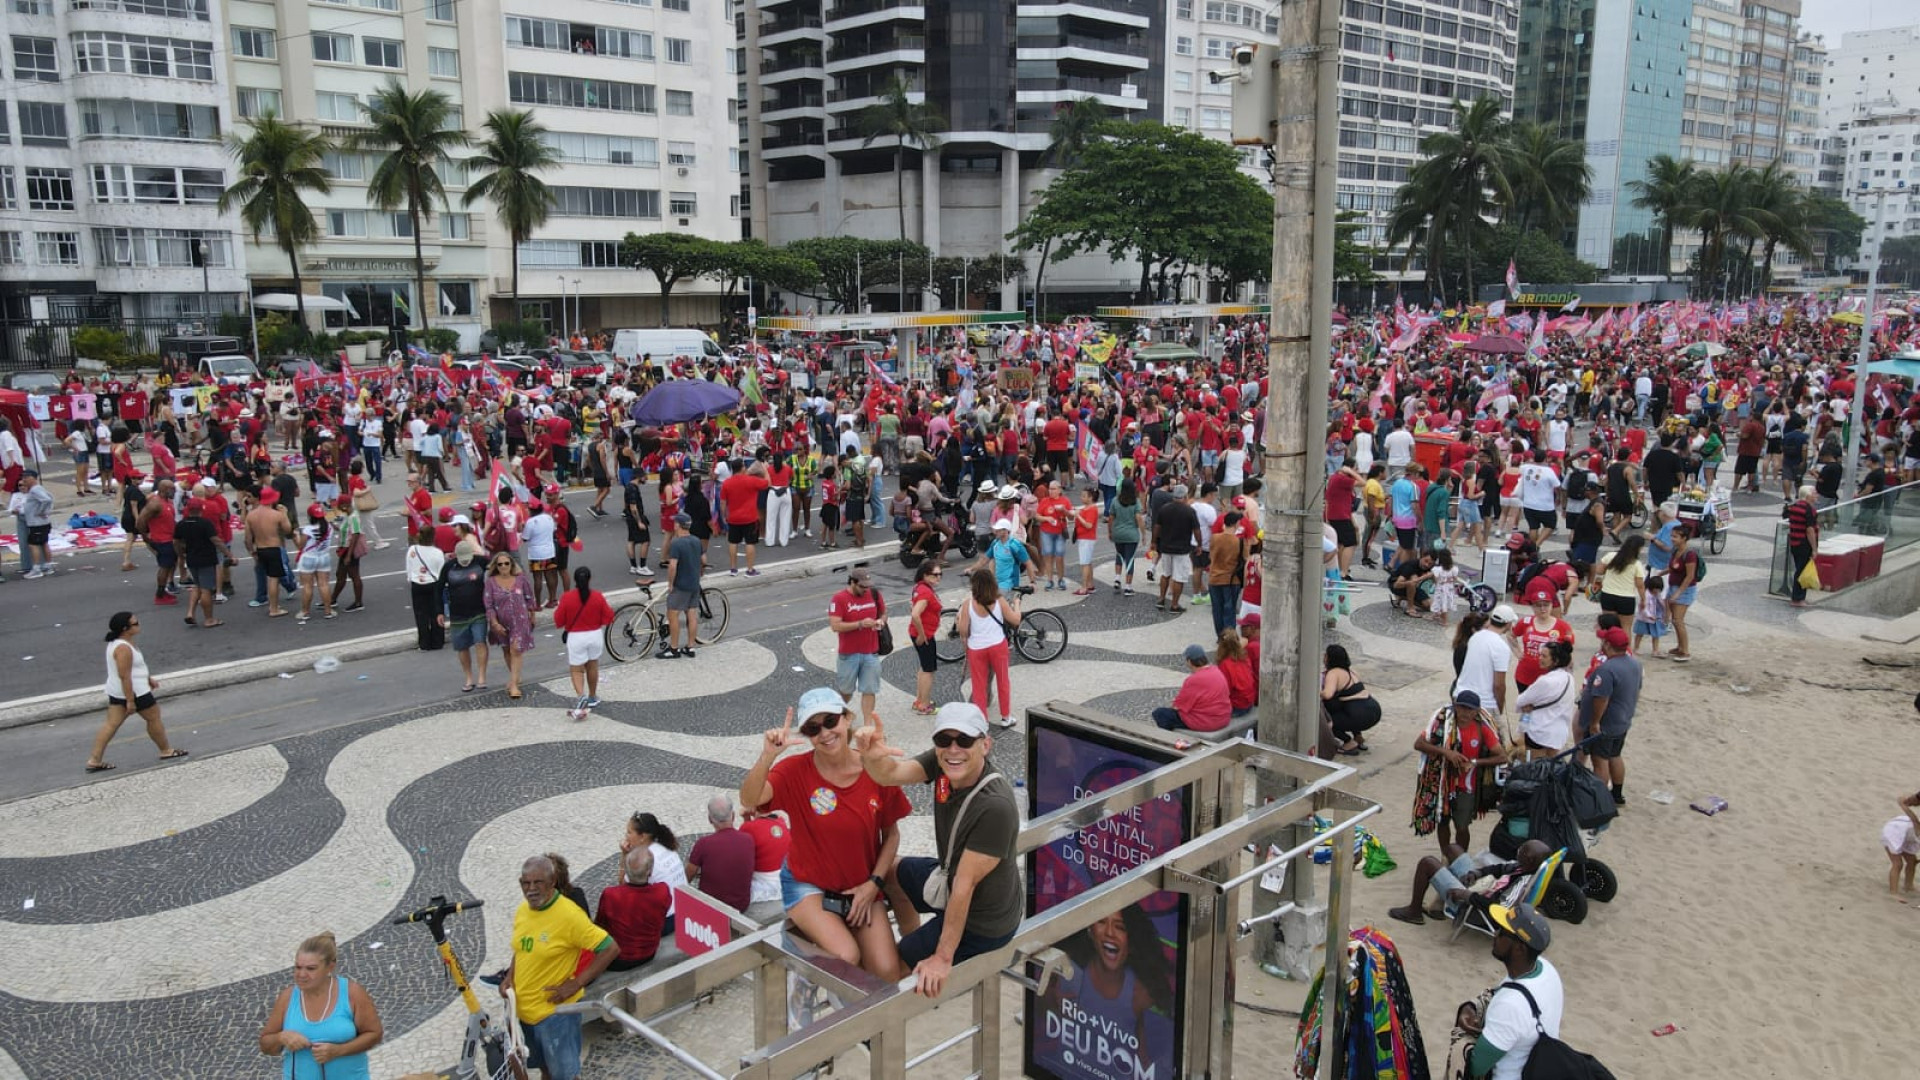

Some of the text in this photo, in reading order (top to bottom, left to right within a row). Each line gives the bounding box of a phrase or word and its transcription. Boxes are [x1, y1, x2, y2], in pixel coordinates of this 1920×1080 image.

[1079, 829, 1099, 849] 5G
[1103, 838, 1151, 865] LÍDER
[1097, 819, 1154, 852] ONTAL,
[1062, 844, 1085, 865] DO
[520, 936, 534, 953] 10
[1046, 1009, 1156, 1080] DEU BOM
